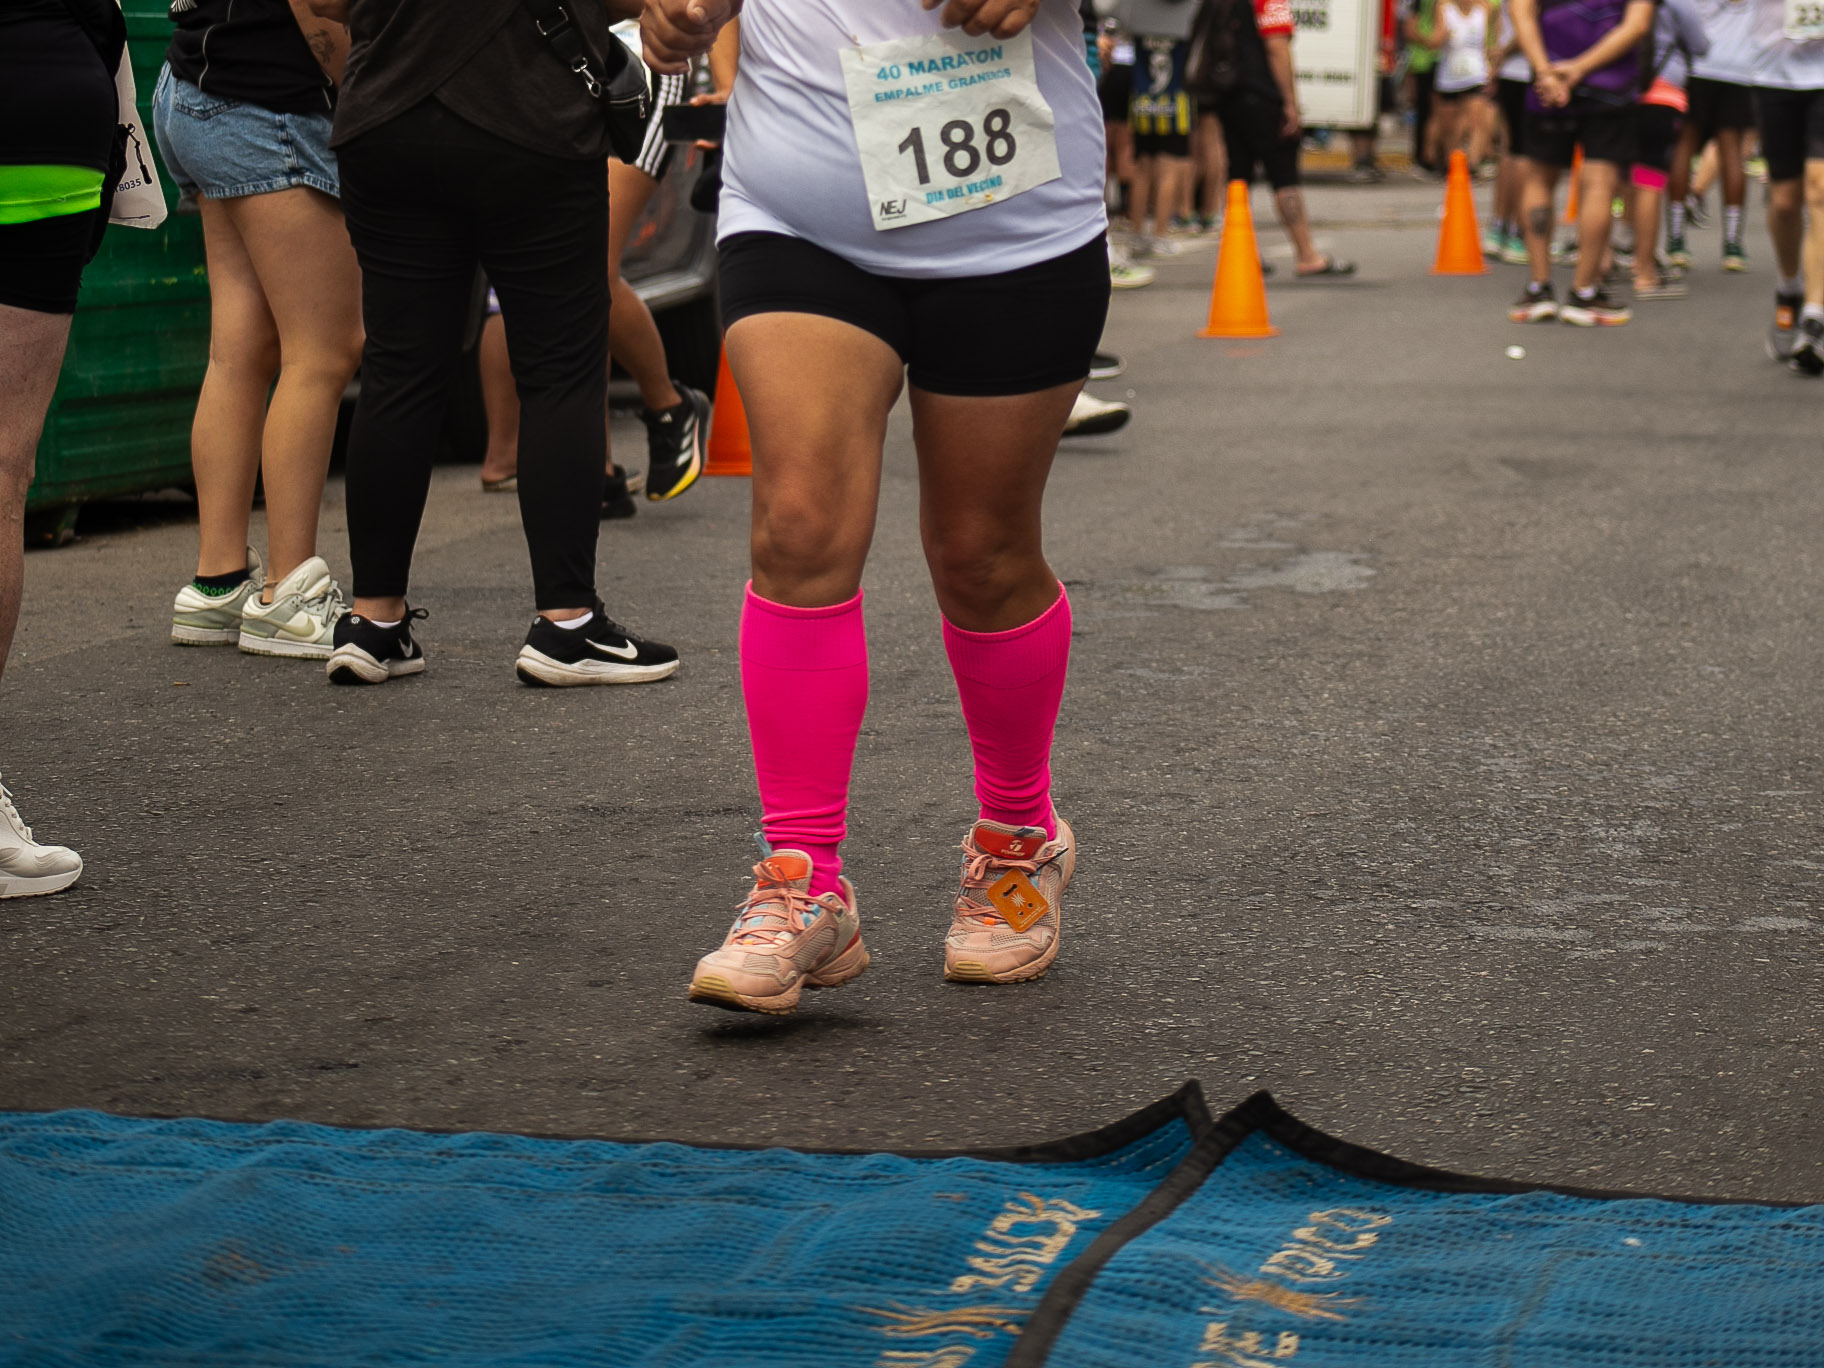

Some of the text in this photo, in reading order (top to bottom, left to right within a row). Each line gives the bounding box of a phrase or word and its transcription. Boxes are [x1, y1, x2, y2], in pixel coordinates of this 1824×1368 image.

[877, 46, 1003, 81] 40 MARATON
[875, 68, 1012, 102] EMPALME GRANEROS
[898, 108, 1017, 185] 188
[925, 175, 1003, 205] DIA DEL VECINO
[879, 199, 907, 216] NEJ
